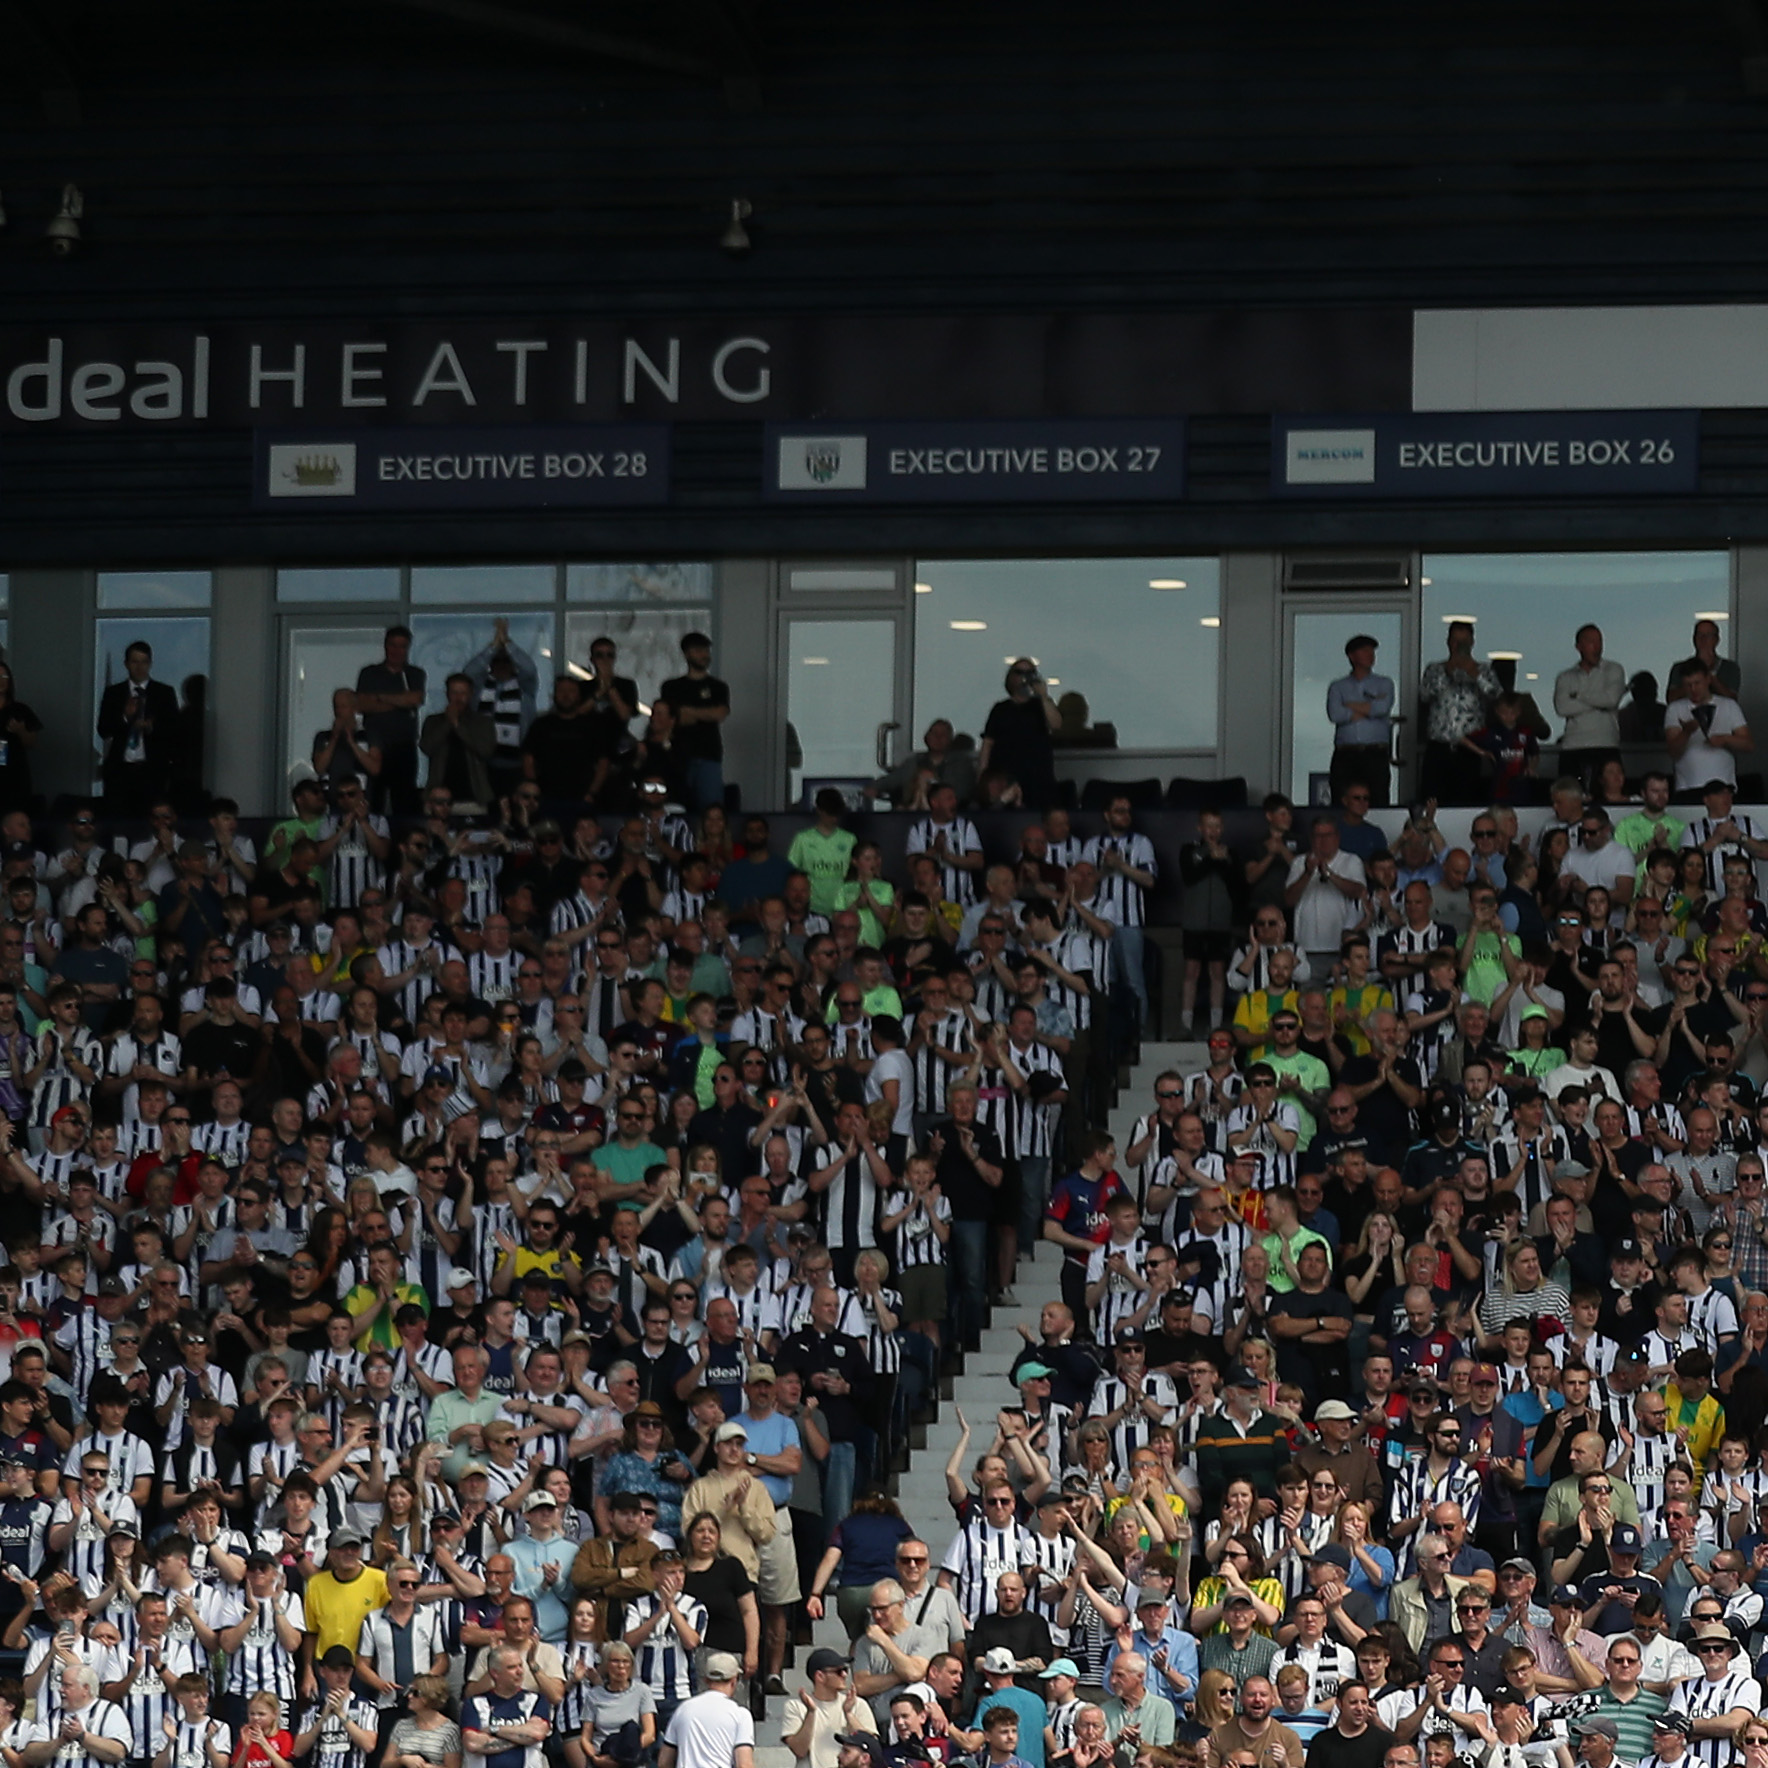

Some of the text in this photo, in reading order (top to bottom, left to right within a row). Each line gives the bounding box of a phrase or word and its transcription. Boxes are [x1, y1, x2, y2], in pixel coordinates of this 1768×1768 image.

[8, 337, 770, 420] deal HEATING
[891, 448, 1160, 473] EXECUTIVE BOX 27
[1400, 440, 1674, 466] EXECUTIVE BOX 26
[380, 453, 646, 479] EXECUTIVE BOX 28
[709, 1367, 741, 1377] ideal
[1630, 1464, 1666, 1477] ideal
[983, 1559, 1016, 1571] ideal
[247, 1760, 272, 1768] ideal
